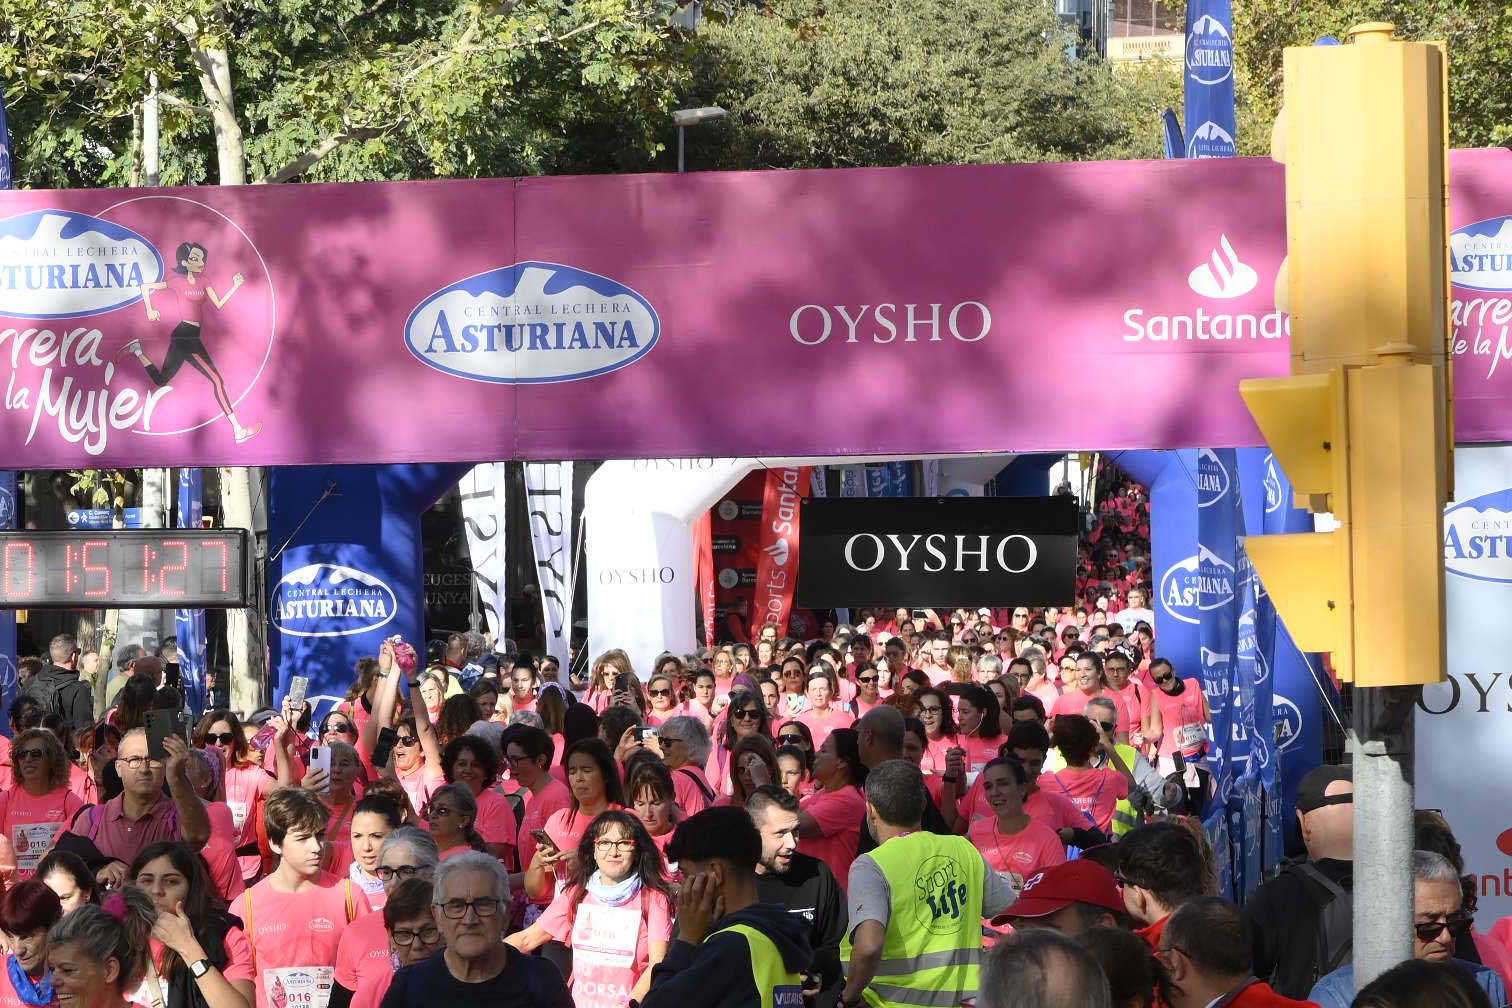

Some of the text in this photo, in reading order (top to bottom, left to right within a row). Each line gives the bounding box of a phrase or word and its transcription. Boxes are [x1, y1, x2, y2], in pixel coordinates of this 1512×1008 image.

[67, 246, 138, 257] LECHERA
[464, 302, 632, 317] CENTRAL LECHERA
[789, 301, 992, 345] OYSHO
[424, 309, 640, 353] ASTURIANA
[5, 371, 30, 411] la
[24, 362, 174, 456] Mujer
[4, 541, 228, 596] 01:51:27
[844, 533, 1037, 573] OYSHO
[287, 587, 382, 598] CENTRAL LECHERA
[599, 566, 675, 585] OYSHO
[275, 594, 388, 620] ASTURIANA
[917, 860, 957, 900] Sport
[926, 880, 966, 921] Life
[289, 993, 311, 1002] 016
